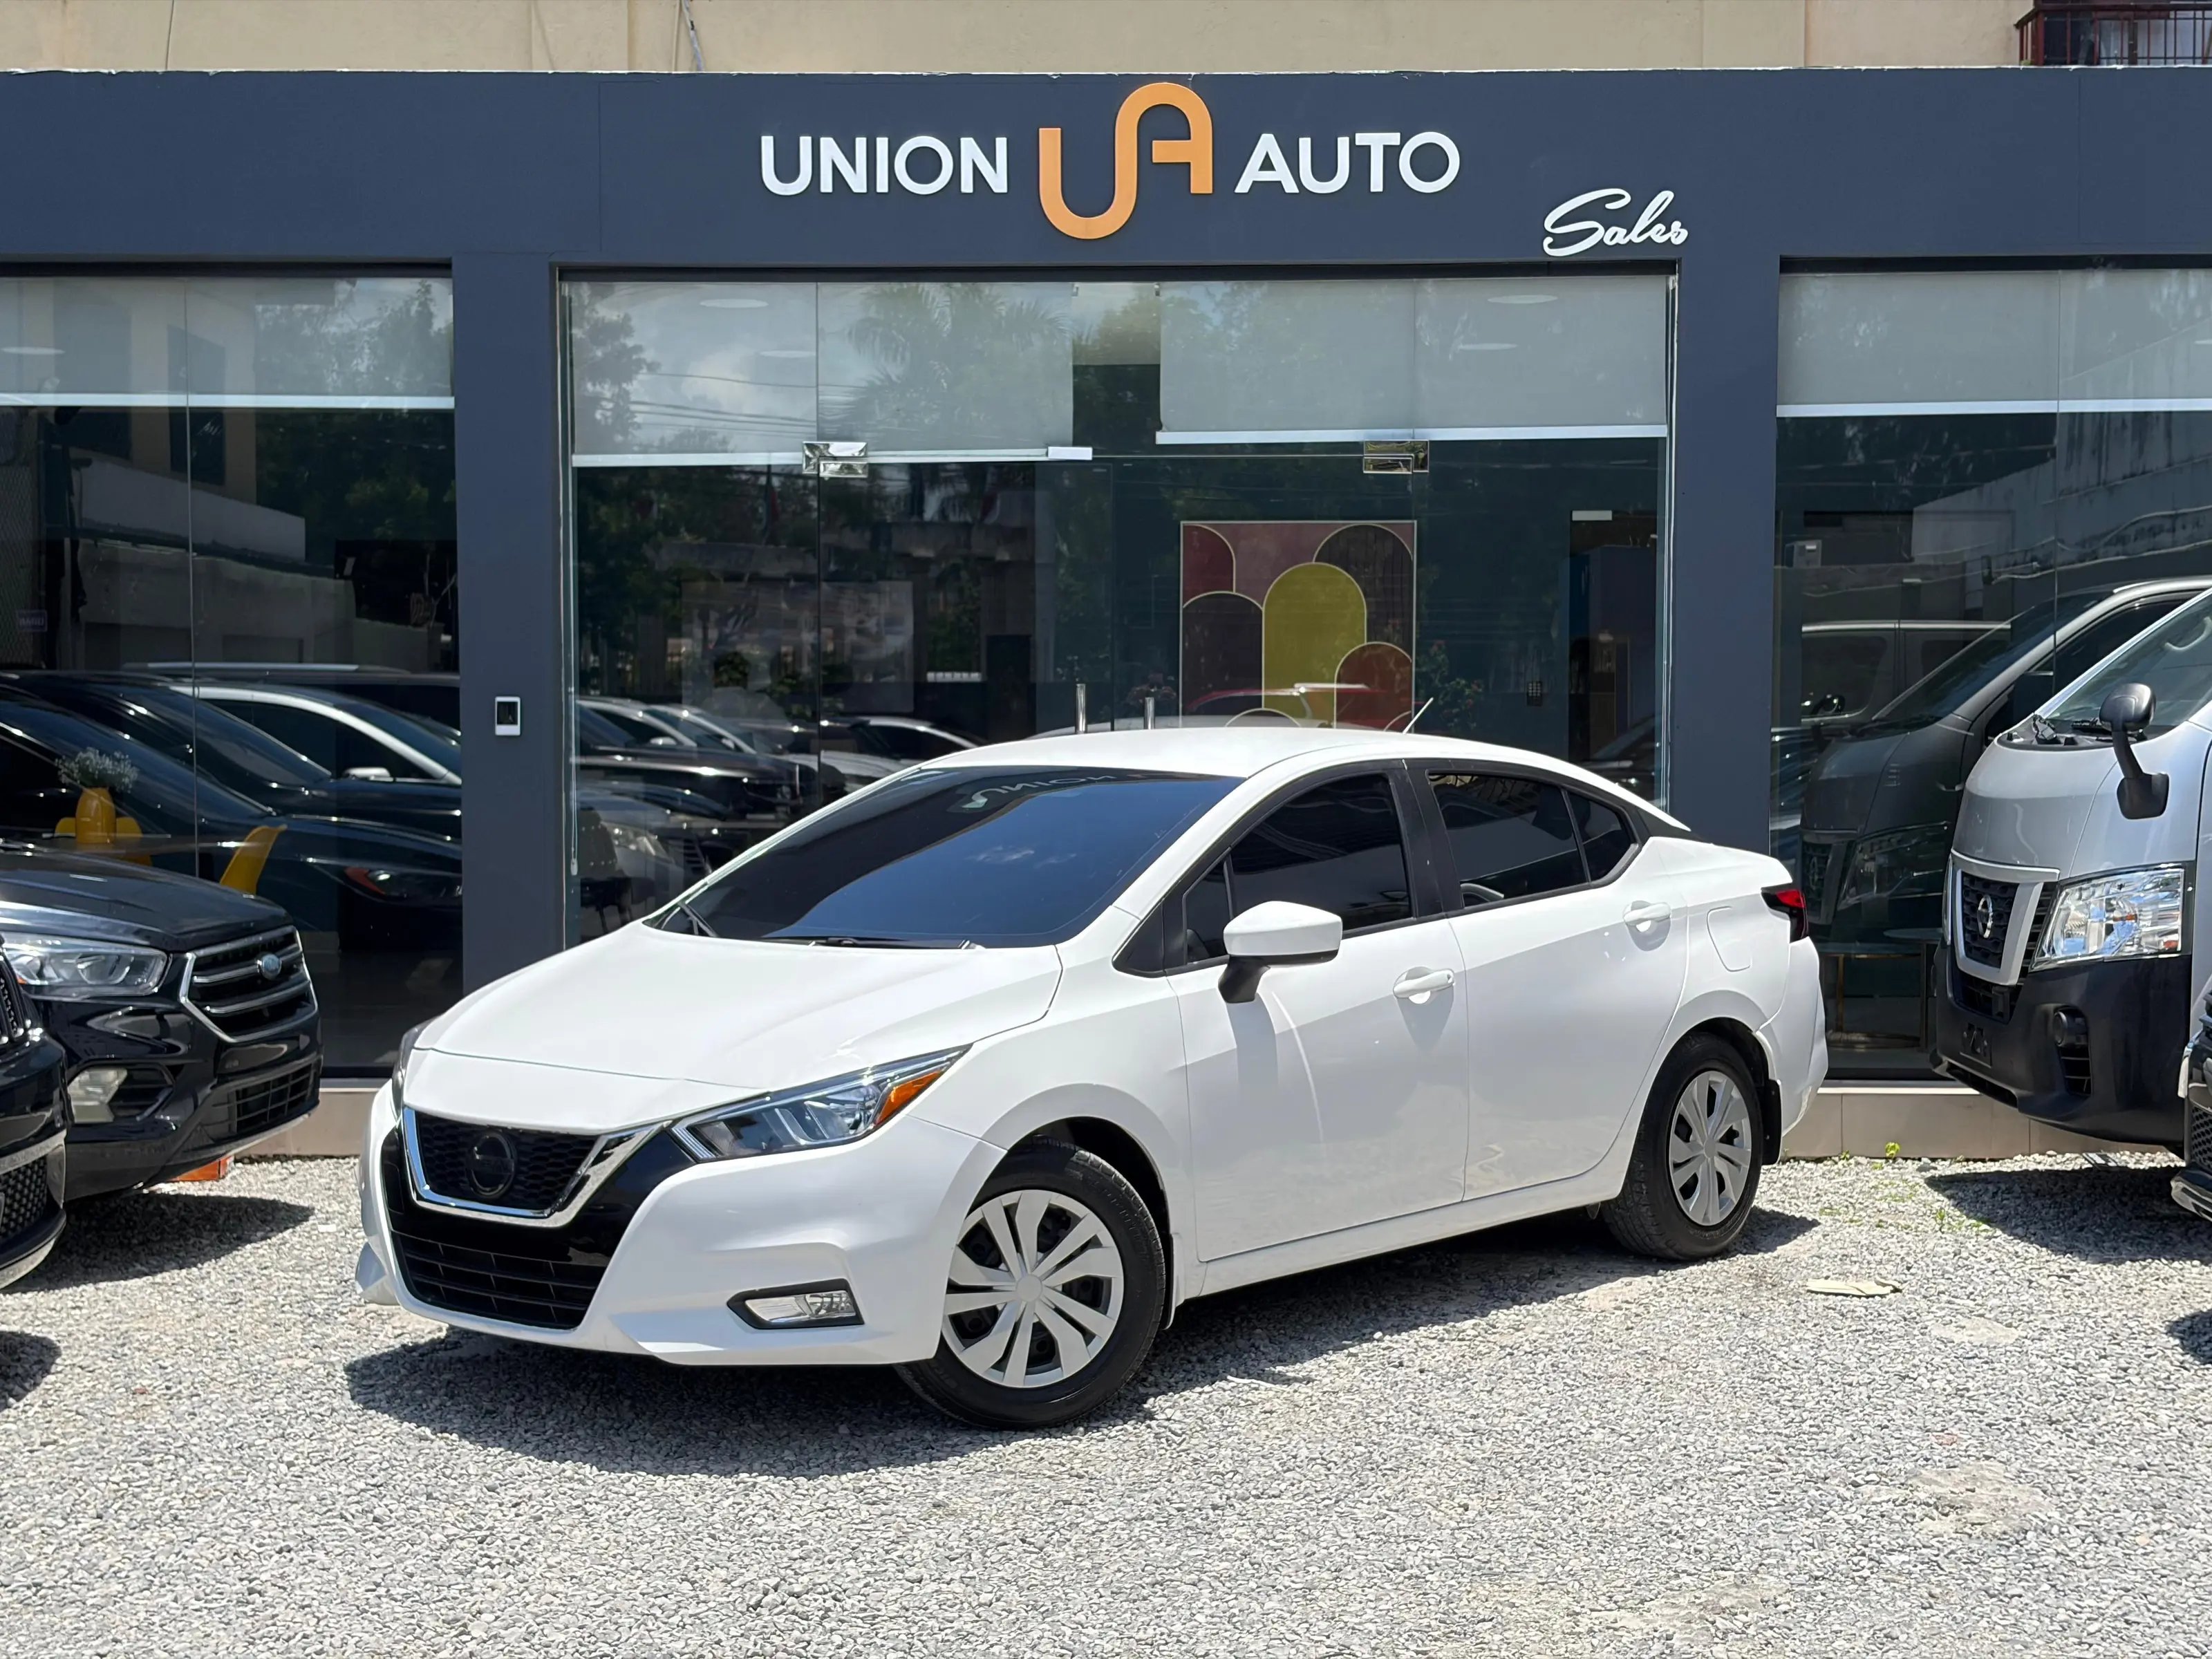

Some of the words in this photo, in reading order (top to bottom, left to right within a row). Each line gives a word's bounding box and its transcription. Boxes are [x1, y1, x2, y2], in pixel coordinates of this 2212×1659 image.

[761, 135, 1009, 196] UNION
[1234, 131, 1461, 194] AUTO
[1543, 187, 1689, 257] Sales
